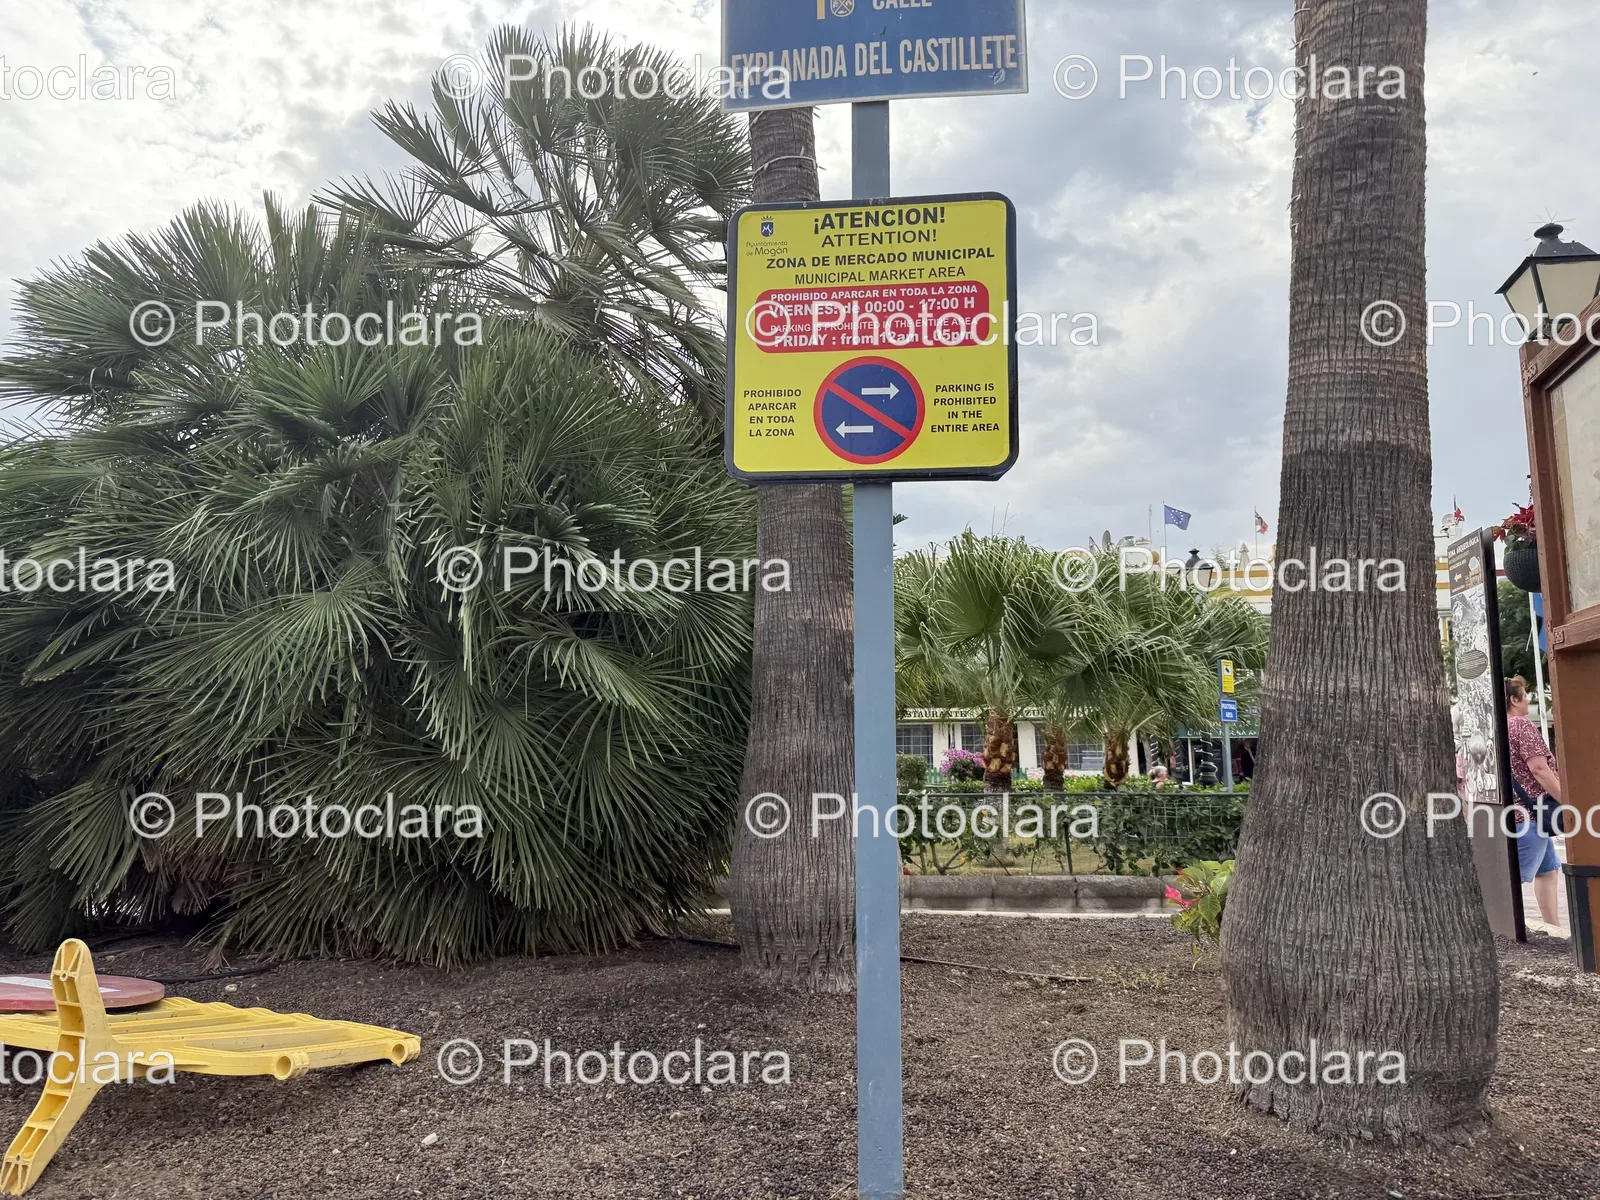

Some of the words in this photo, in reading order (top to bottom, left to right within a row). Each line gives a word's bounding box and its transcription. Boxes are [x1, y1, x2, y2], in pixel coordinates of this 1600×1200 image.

[731, 45, 847, 88] EXPLANADA
[855, 41, 892, 77] DEL
[899, 35, 1017, 74] CASTILLETE
[813, 206, 945, 235] ¡ATENCION!
[821, 229, 937, 248] ATTENTION!
[754, 246, 788, 257] Mogán
[766, 257, 807, 270] ZONA
[811, 256, 830, 267] DE
[835, 252, 907, 266] MERCADO
[913, 247, 995, 261] MUNICIPAL
[795, 271, 865, 285] MUNICIPAL
[869, 268, 925, 282] MARKET
[928, 266, 965, 278] AREA
[771, 292, 828, 302] PROHIBIDO
[831, 290, 879, 300] APARCAR
[882, 289, 897, 297] EN
[900, 287, 928, 297] TODA
[931, 286, 945, 295] LA
[947, 285, 978, 294] ZONA
[768, 302, 839, 317] VIERNES:
[843, 300, 860, 314] de
[864, 298, 905, 313] 00:00
[918, 297, 959, 311] 17:00
[964, 296, 975, 309] H
[770, 323, 811, 333] PARKING
[824, 320, 880, 332] PROHIBITED
[894, 319, 912, 328] THE
[915, 318, 948, 327] ENTIRE
[951, 317, 978, 326] AREA
[774, 334, 827, 348] FRIDAY
[840, 332, 874, 345] from
[743, 388, 802, 398] PROHIBIDO
[935, 384, 981, 393] PARKING
[983, 383, 995, 392] IS
[748, 402, 797, 411] APARCAR
[933, 396, 997, 406] PROHIBITED
[749, 416, 763, 424] EN
[767, 415, 795, 424] TODA
[947, 410, 958, 419] IN
[961, 410, 983, 419] THE
[749, 429, 763, 437] LA
[766, 428, 795, 437] ZONA
[930, 424, 968, 433] ENTIRE
[972, 423, 1000, 432] AREA
